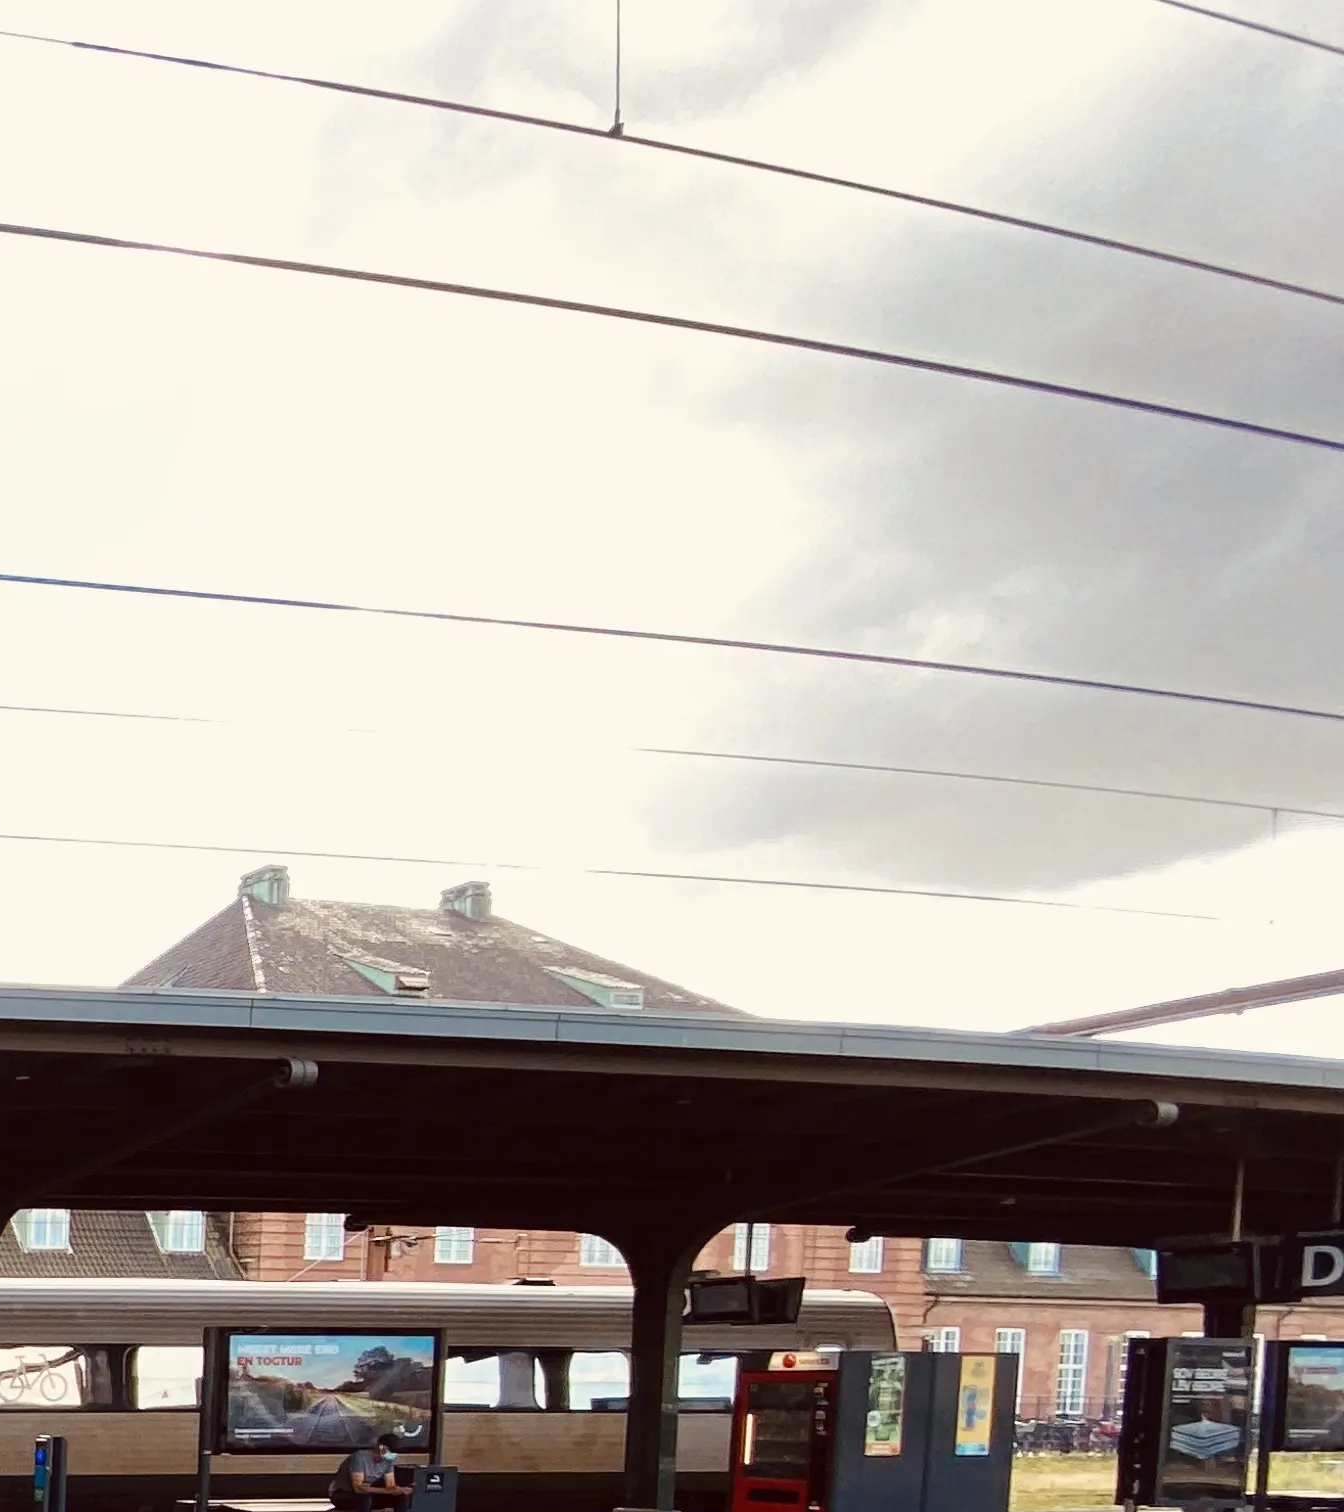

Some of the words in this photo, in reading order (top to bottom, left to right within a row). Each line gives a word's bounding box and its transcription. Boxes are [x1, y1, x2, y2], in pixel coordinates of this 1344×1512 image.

[1301, 1245, 1344, 1287] D
[237, 1356, 253, 1366] EN
[255, 1356, 303, 1366] TOGTUR
